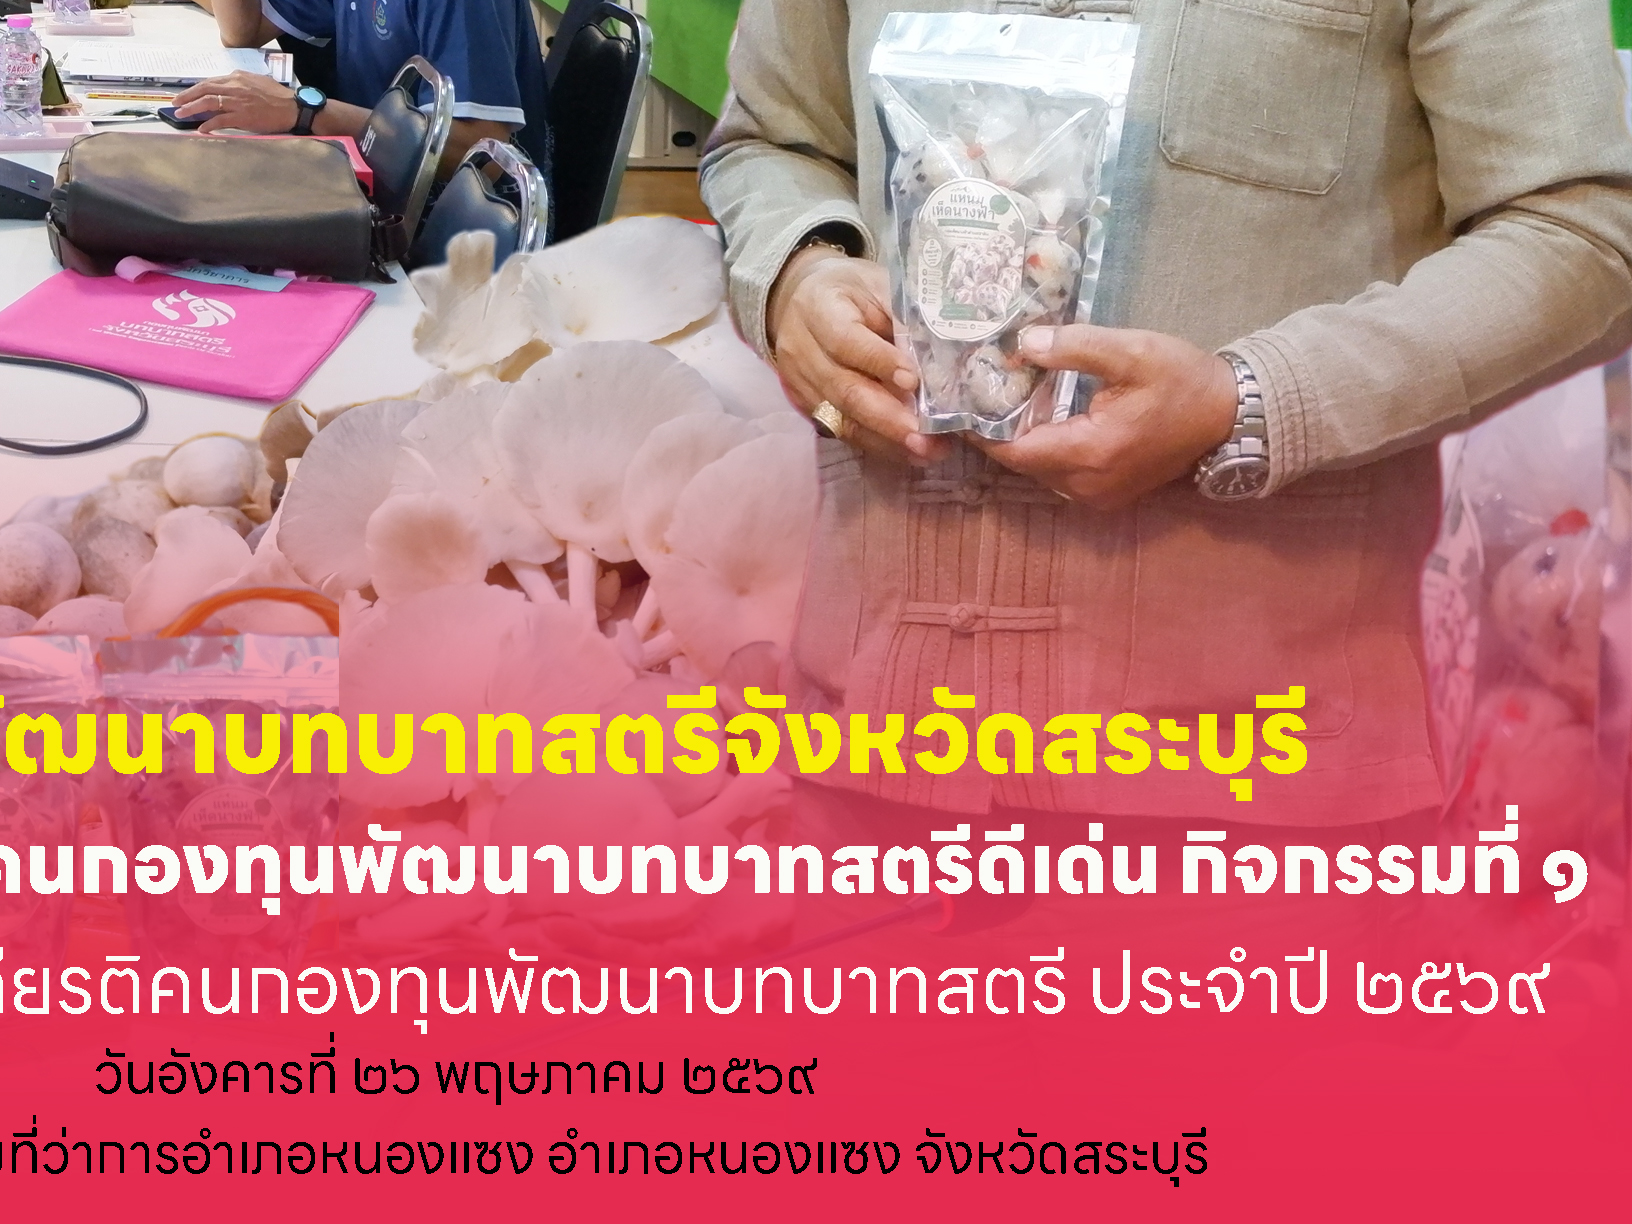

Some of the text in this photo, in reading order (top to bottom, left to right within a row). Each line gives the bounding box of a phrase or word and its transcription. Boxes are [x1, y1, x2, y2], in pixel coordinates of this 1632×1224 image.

[932, 200, 995, 221] เห็ดนางฟ้า
[950, 193, 985, 206] แหนม
[102, 324, 232, 353] จังหวัดสระบุรี
[119, 321, 226, 345] บทบาทสตรี
